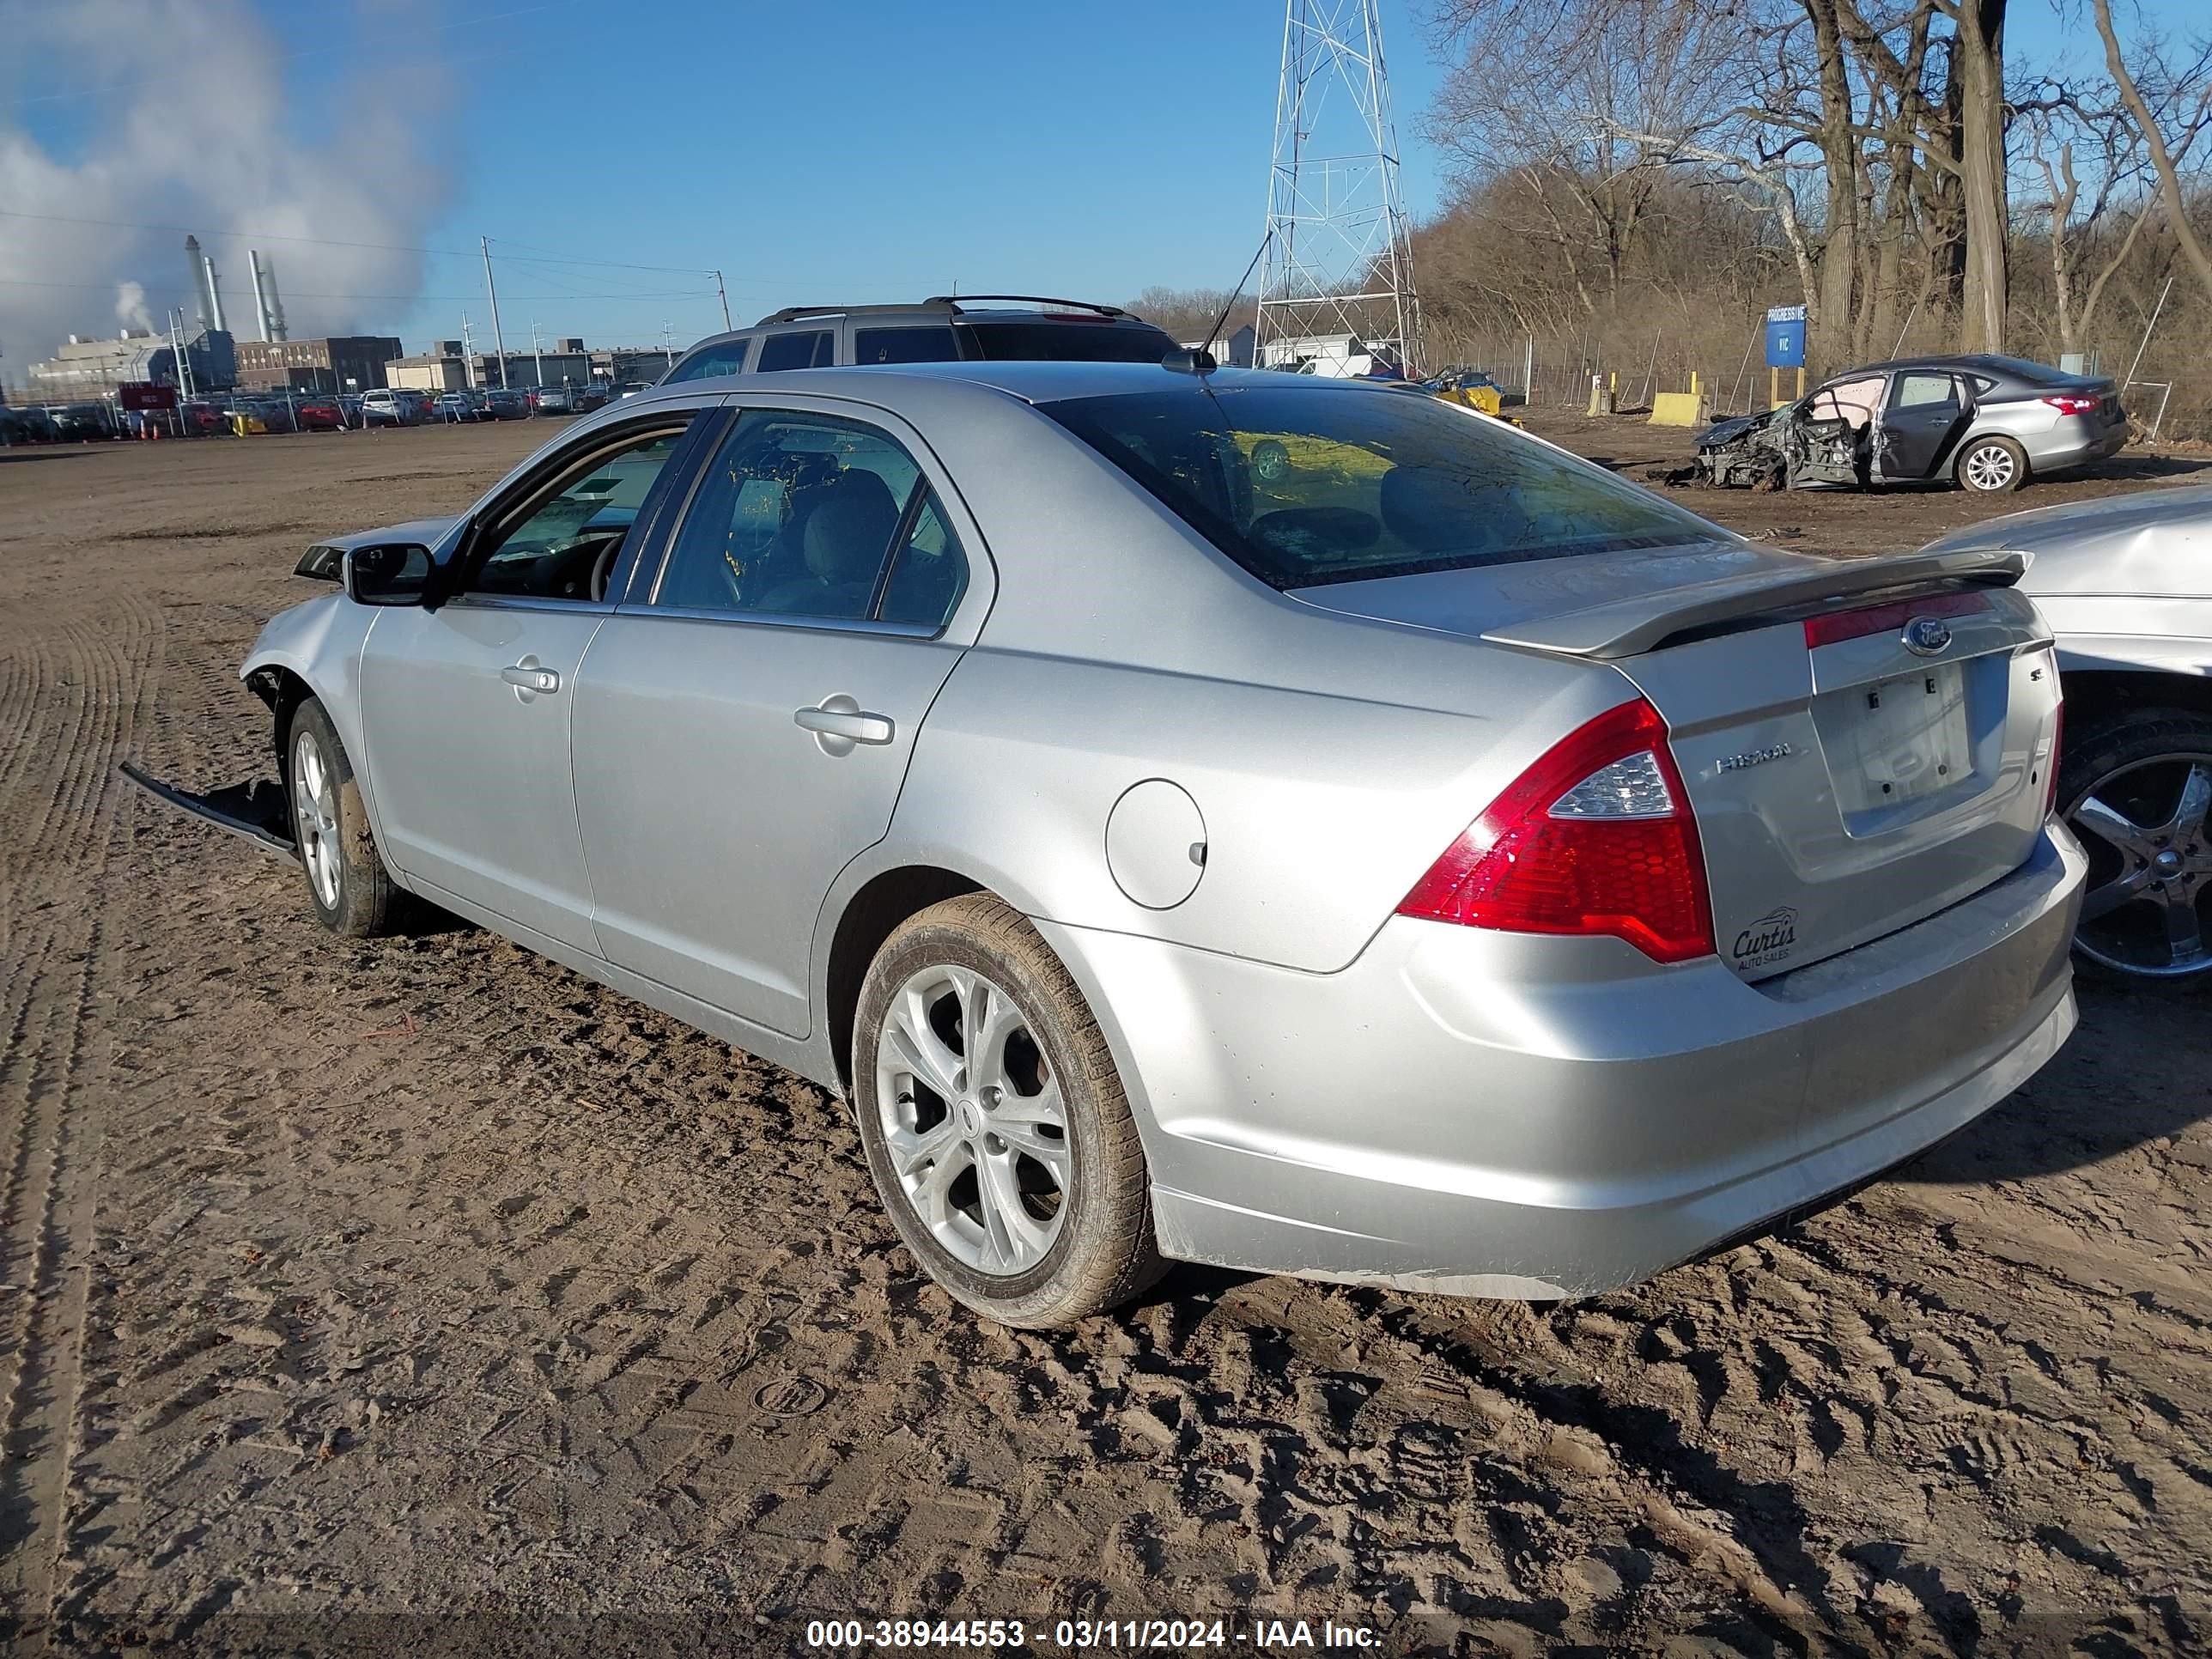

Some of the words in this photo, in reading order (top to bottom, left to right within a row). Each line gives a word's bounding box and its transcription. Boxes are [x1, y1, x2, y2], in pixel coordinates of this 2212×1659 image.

[1767, 305, 1805, 321] PROGRESSIVE
[1920, 622, 1948, 644] Ford
[1733, 926, 1796, 958] Curtis
[1738, 957, 1762, 971] AUTO
[1764, 948, 1790, 964] SALES
